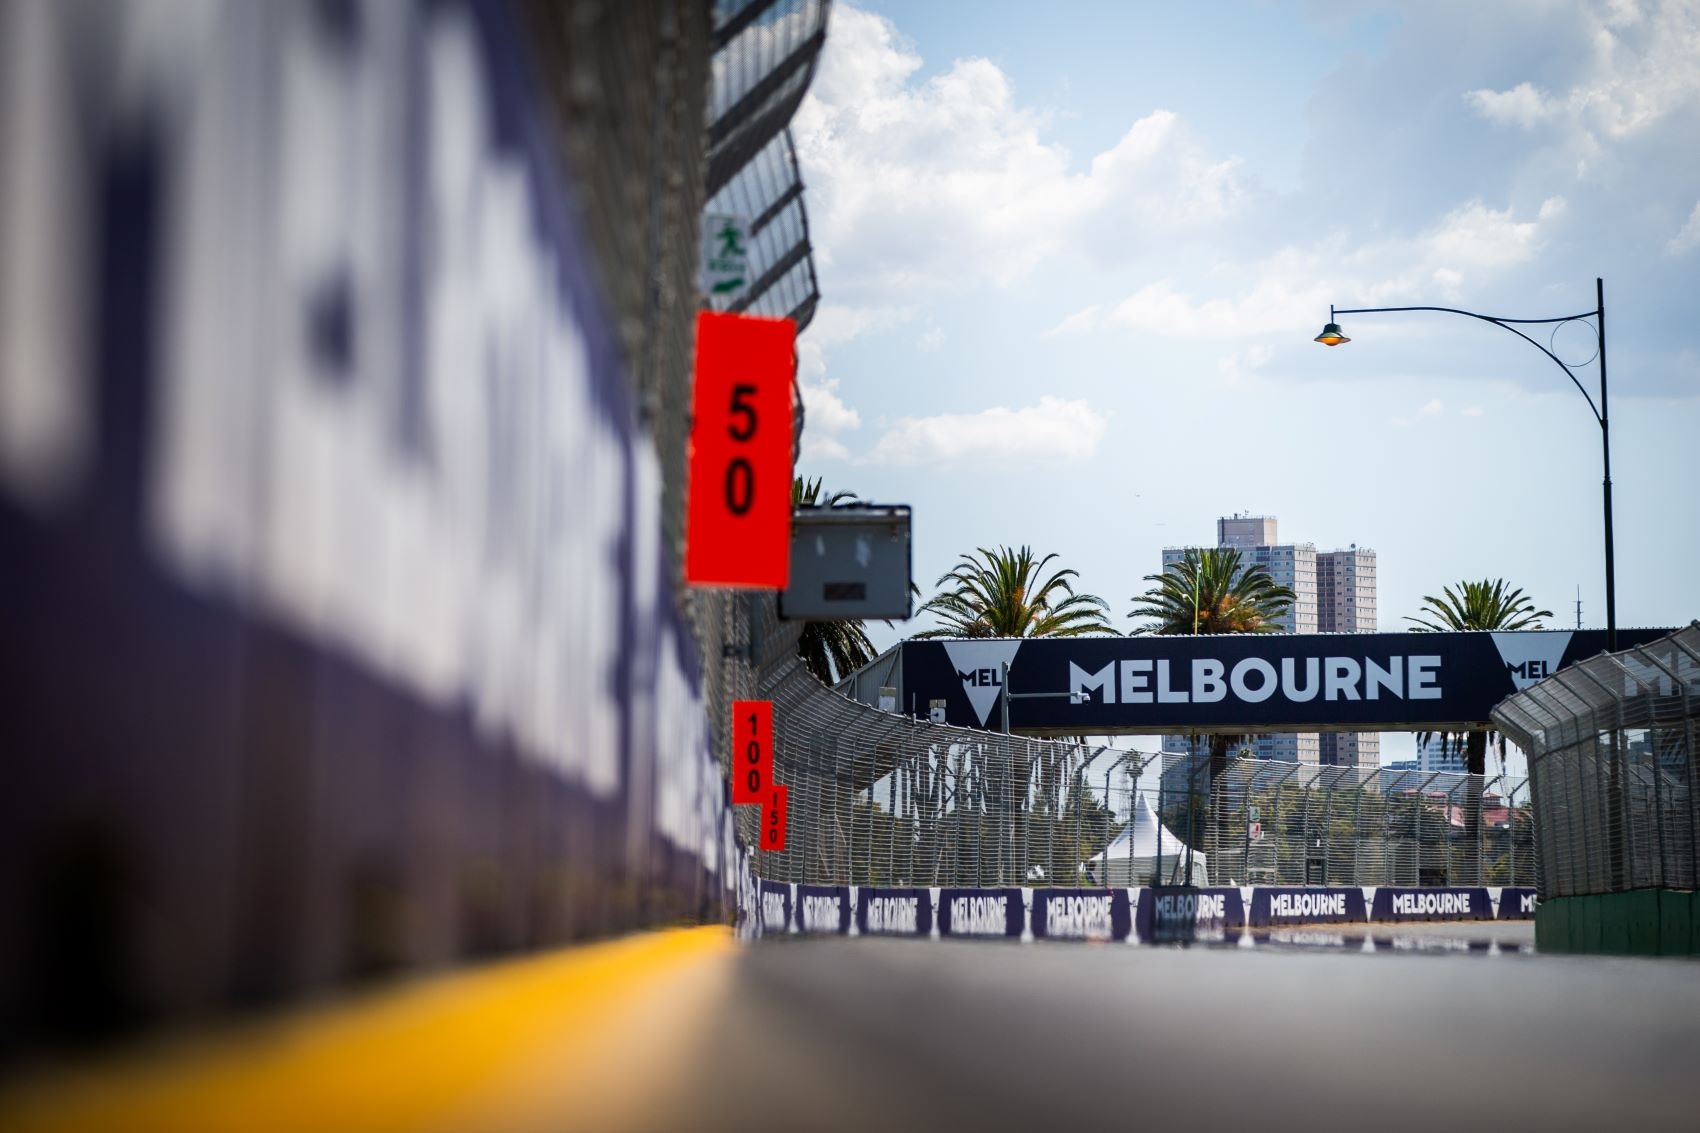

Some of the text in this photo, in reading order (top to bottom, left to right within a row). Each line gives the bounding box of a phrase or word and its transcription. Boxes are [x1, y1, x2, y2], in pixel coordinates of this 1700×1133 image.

[725, 384, 759, 515] 50
[958, 668, 1002, 687] MEL
[1069, 655, 1442, 705] MELBOURNE
[1507, 660, 1552, 679] MEL
[747, 712, 760, 793] 100
[769, 792, 779, 844] 150
[951, 896, 1007, 933] MELBOURNE
[1046, 896, 1113, 935] MELBOURNE
[1155, 894, 1225, 920] MELBOURNE
[1270, 893, 1346, 916] MELBOURNE
[1392, 893, 1471, 914] MELBOURNE
